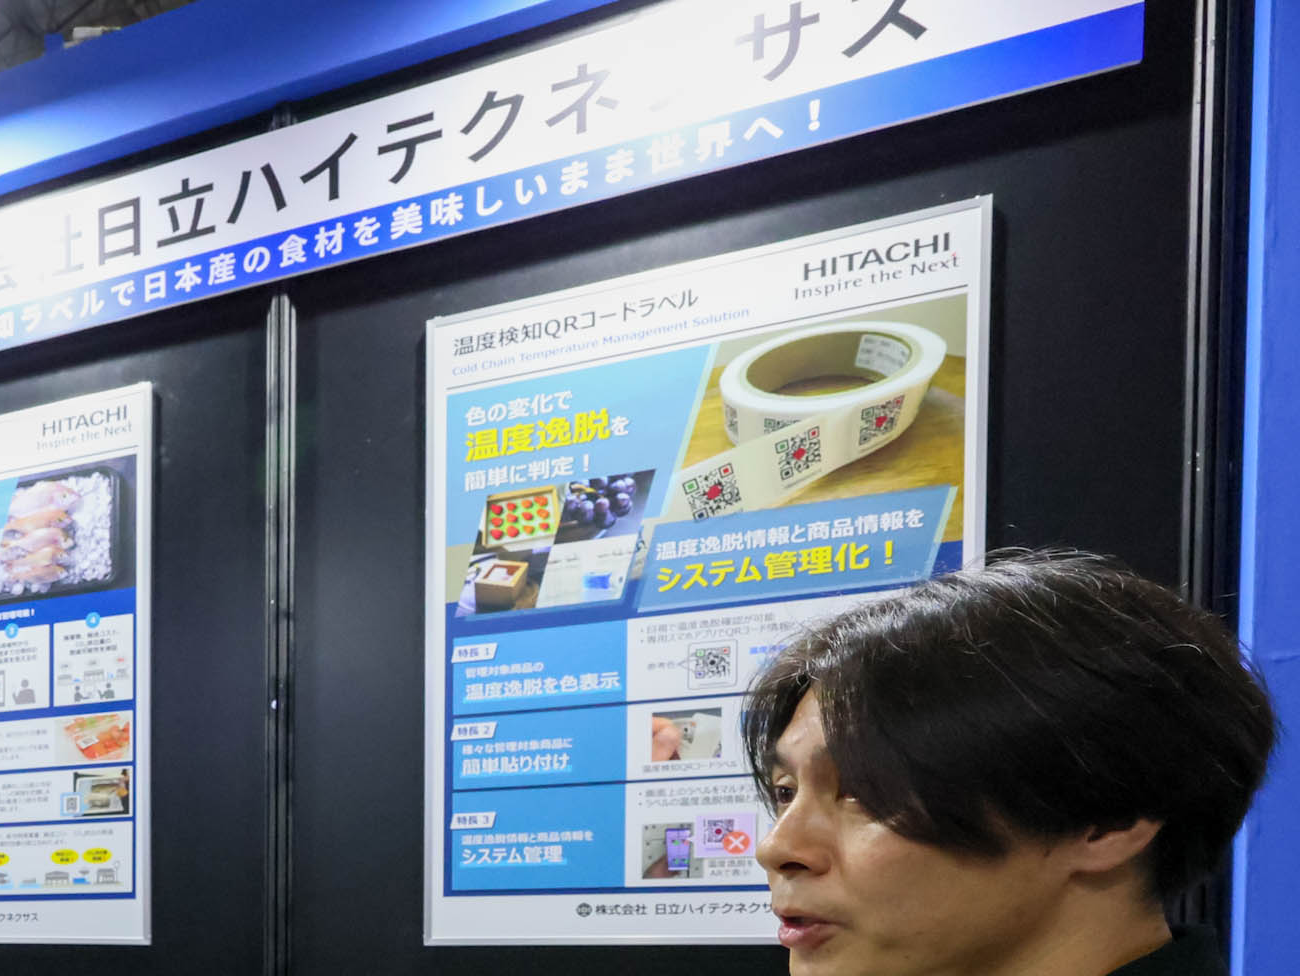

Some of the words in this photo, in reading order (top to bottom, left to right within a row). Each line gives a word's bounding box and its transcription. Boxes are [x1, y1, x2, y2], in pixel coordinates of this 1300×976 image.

[802, 231, 952, 281] HITACHI
[794, 275, 862, 301] Inspire
[869, 266, 903, 286] the
[910, 254, 961, 276] Next
[452, 364, 478, 377] Cold
[481, 355, 515, 371] Chain
[518, 338, 599, 366] Temperature
[602, 321, 688, 348] Management
[691, 306, 751, 328] Solution
[453, 290, 698, 358] 温度検知QRコードラベル
[41, 404, 128, 437] HITACHI
[464, 390, 573, 427] 色の変化で
[37, 430, 77, 452] Inspire
[81, 428, 102, 442] the
[104, 422, 132, 438] Next
[464, 408, 630, 463] 温度逸脱を
[463, 456, 592, 492] 簡単に判定！
[655, 509, 926, 562] 温度逸脱情報と商品情報を
[656, 539, 895, 593] システム管理化！
[465, 671, 621, 701] 温度逸脱を色表示
[461, 752, 571, 776] 簡単貼り付け
[461, 845, 563, 865] システム管理
[595, 903, 647, 916] 株式会社
